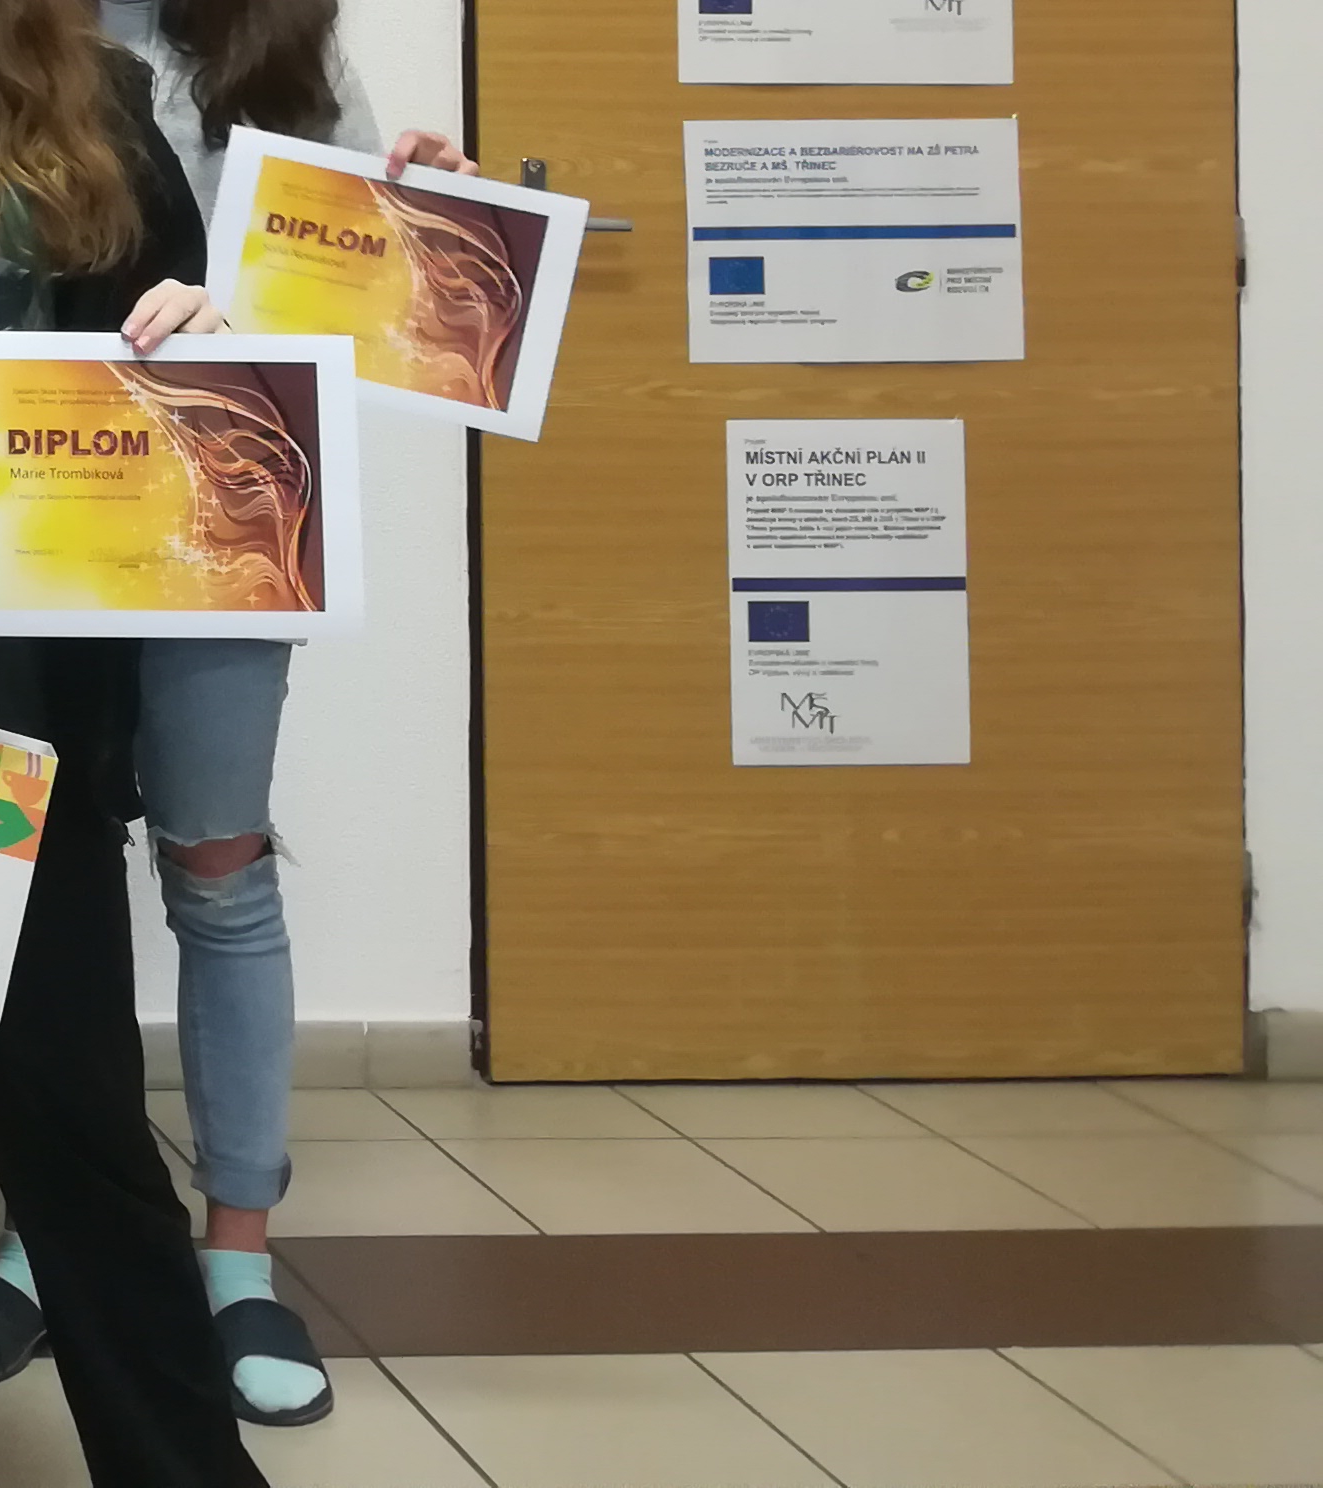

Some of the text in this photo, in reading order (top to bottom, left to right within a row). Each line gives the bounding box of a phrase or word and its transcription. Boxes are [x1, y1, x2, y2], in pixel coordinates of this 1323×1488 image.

[704, 147, 786, 157] MODERNIZACE
[789, 147, 797, 156] A
[907, 146, 924, 156] NA
[944, 145, 980, 156] PETRA
[760, 161, 769, 171] A
[266, 212, 387, 258] DIPLOM
[8, 429, 150, 457] DIPLOM
[745, 447, 926, 464] MÍSTNÍ AKČNÍ PLÁN II
[10, 467, 124, 480] Marie Trombiková
[746, 469, 867, 487] V ORP TŘINEC
